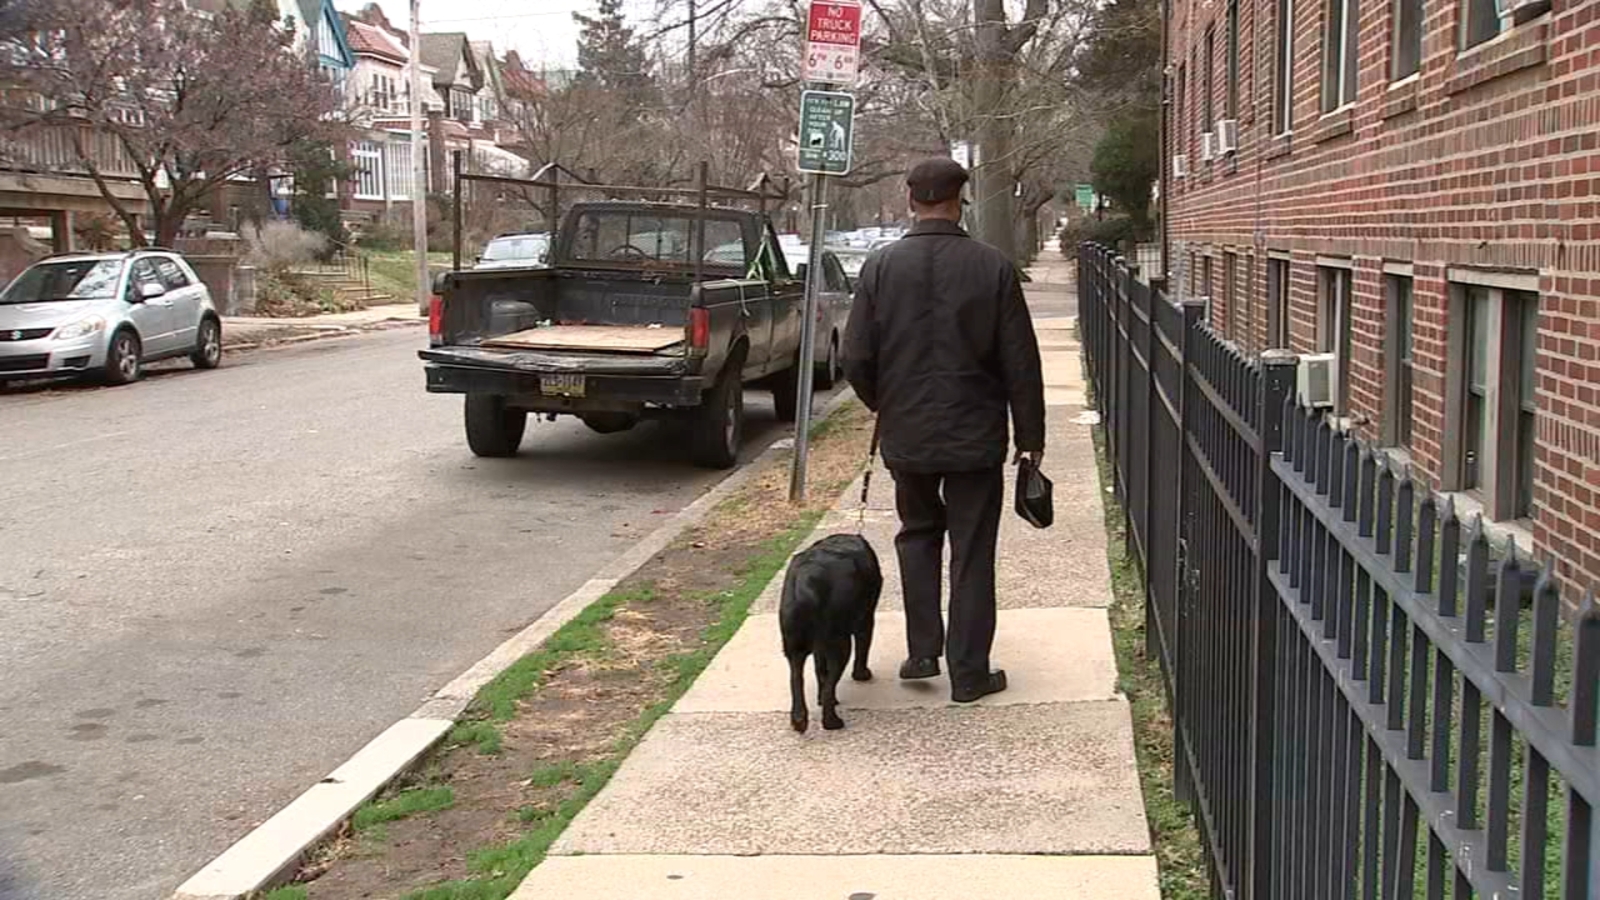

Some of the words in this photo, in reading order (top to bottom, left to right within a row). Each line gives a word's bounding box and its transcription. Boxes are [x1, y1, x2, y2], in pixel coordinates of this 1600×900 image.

[828, 6, 844, 18] NO
[816, 17, 852, 30] TRUCK
[810, 30, 856, 44] PARKING
